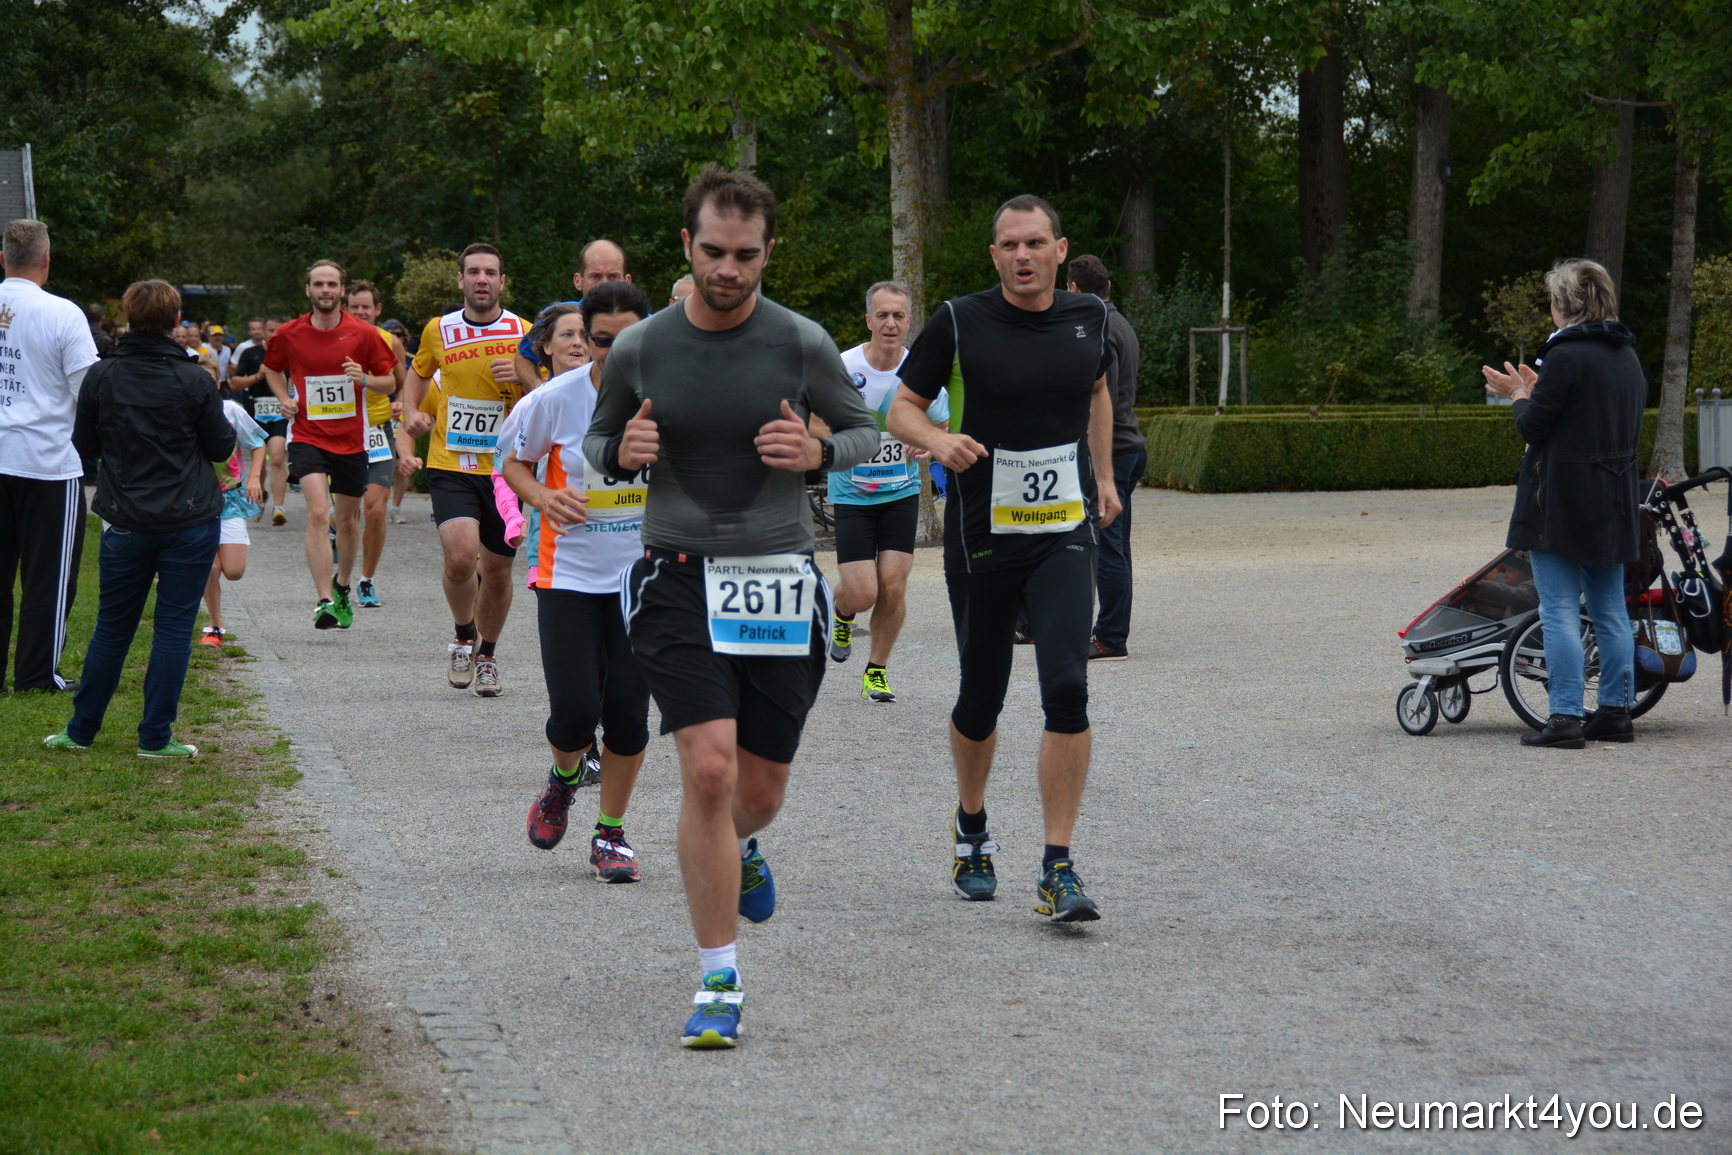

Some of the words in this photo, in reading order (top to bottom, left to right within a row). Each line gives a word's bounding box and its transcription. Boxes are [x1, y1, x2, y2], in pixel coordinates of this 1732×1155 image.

[445, 349, 479, 365] MAX
[316, 386, 344, 402] 151
[257, 403, 281, 414] 2375
[322, 406, 343, 414] Martin
[449, 401, 466, 410] PARTL
[467, 404, 495, 412] Neumarkt
[452, 410, 499, 433] 2767
[457, 435, 489, 446] Andreas
[861, 443, 903, 464] 233
[996, 457, 1026, 469] PARTL
[1028, 455, 1067, 468] Neumarkt
[868, 468, 894, 478] Johann
[1022, 469, 1059, 503] 32
[614, 492, 642, 506] Jutta
[1011, 509, 1067, 525] Wolfgang
[707, 564, 745, 576] PARTL
[746, 565, 800, 575] Neumarkt
[719, 578, 804, 616] 2611
[739, 623, 787, 641] Patrick
[1421, 633, 1468, 650] chariot
